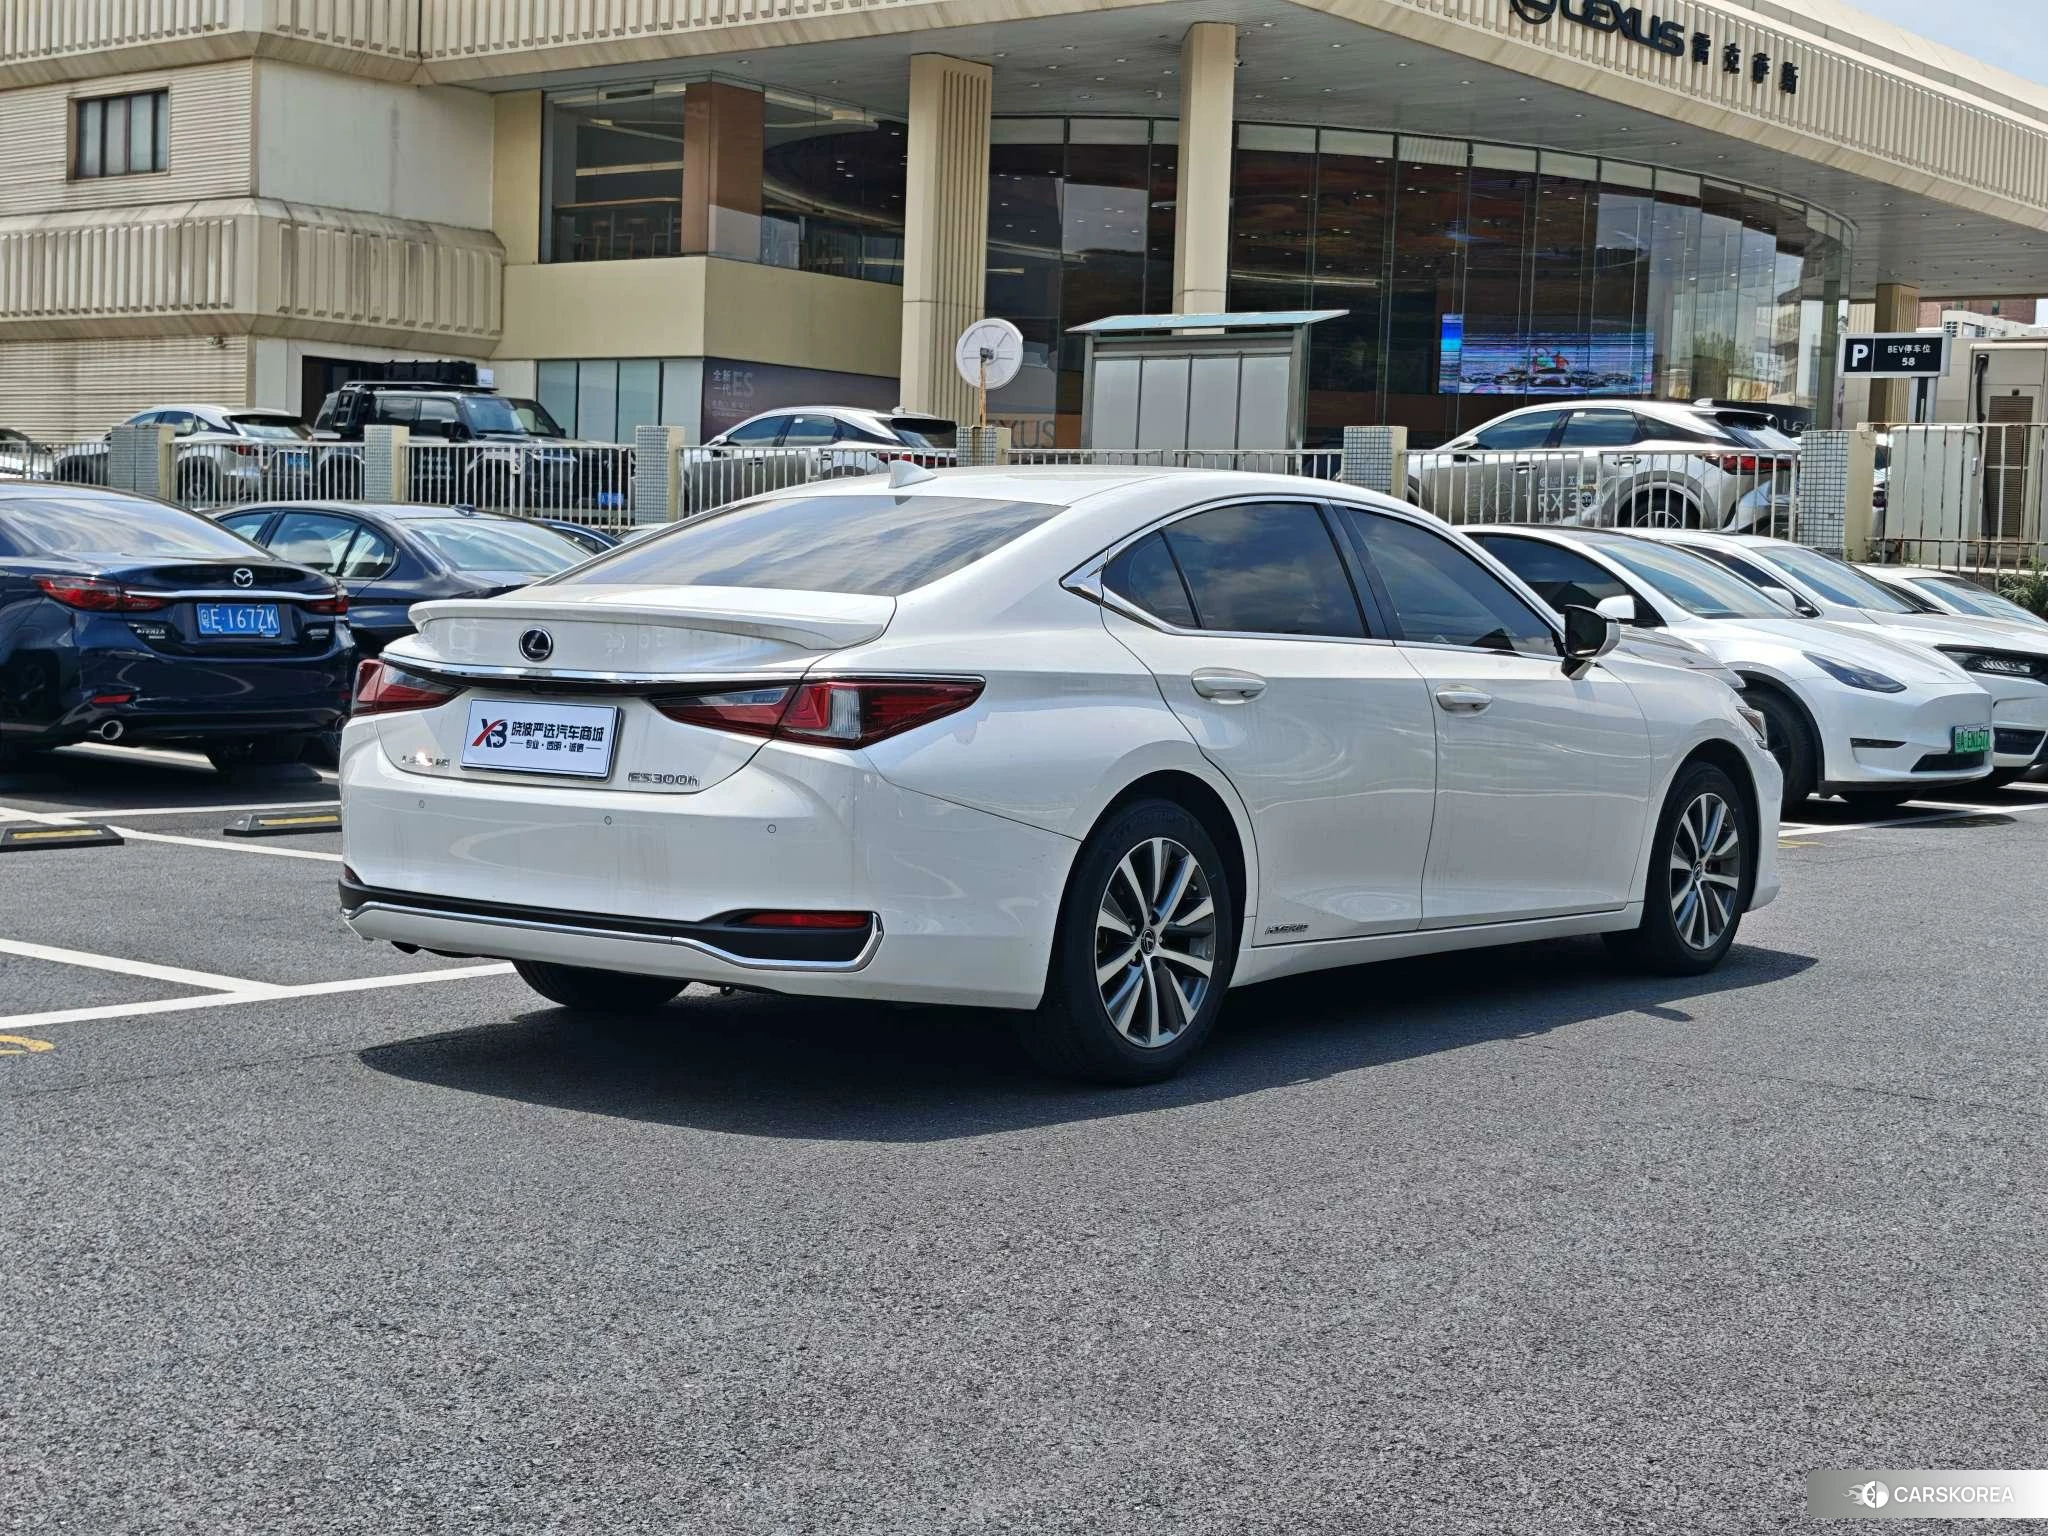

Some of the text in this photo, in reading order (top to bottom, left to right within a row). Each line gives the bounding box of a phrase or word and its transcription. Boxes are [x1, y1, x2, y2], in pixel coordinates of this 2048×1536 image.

[1560, 0, 1685, 56] LEXUS
[1851, 344, 1869, 367] P
[1887, 344, 1931, 353] BEV停车位
[1901, 357, 1915, 366] 58
[628, 772, 700, 788] ES300h
